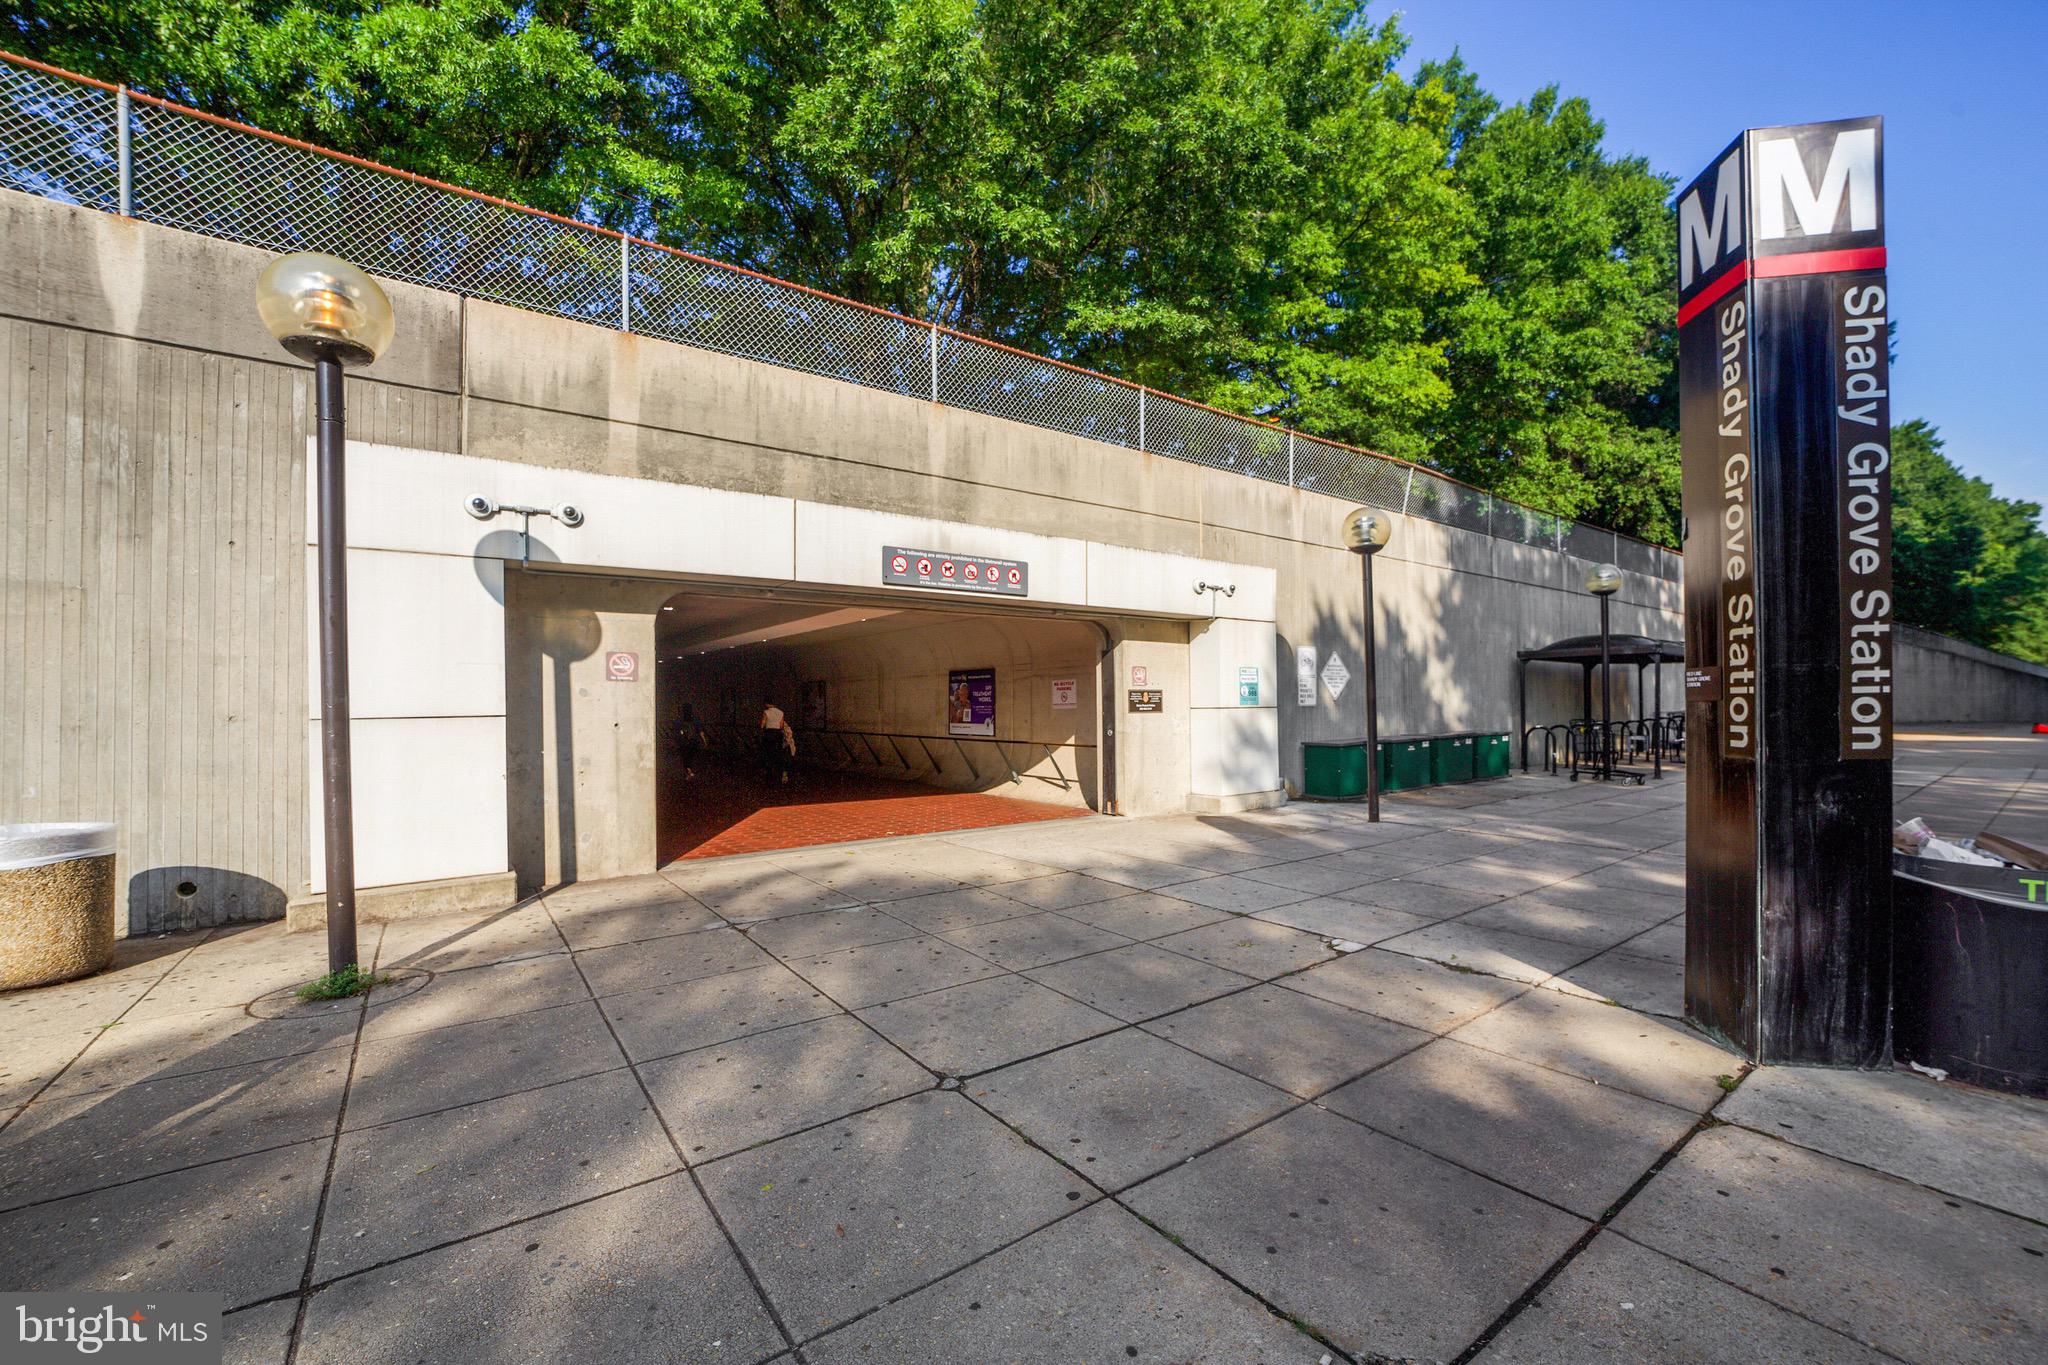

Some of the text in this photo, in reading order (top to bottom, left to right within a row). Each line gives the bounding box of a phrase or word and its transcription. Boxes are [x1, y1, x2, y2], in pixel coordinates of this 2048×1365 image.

[1680, 147, 1743, 293] M
[1757, 128, 1878, 241] M
[1718, 299, 1754, 750] Shady Grove Station
[1837, 285, 1891, 752] Shady Grove Station
[2018, 878, 2048, 903] T
